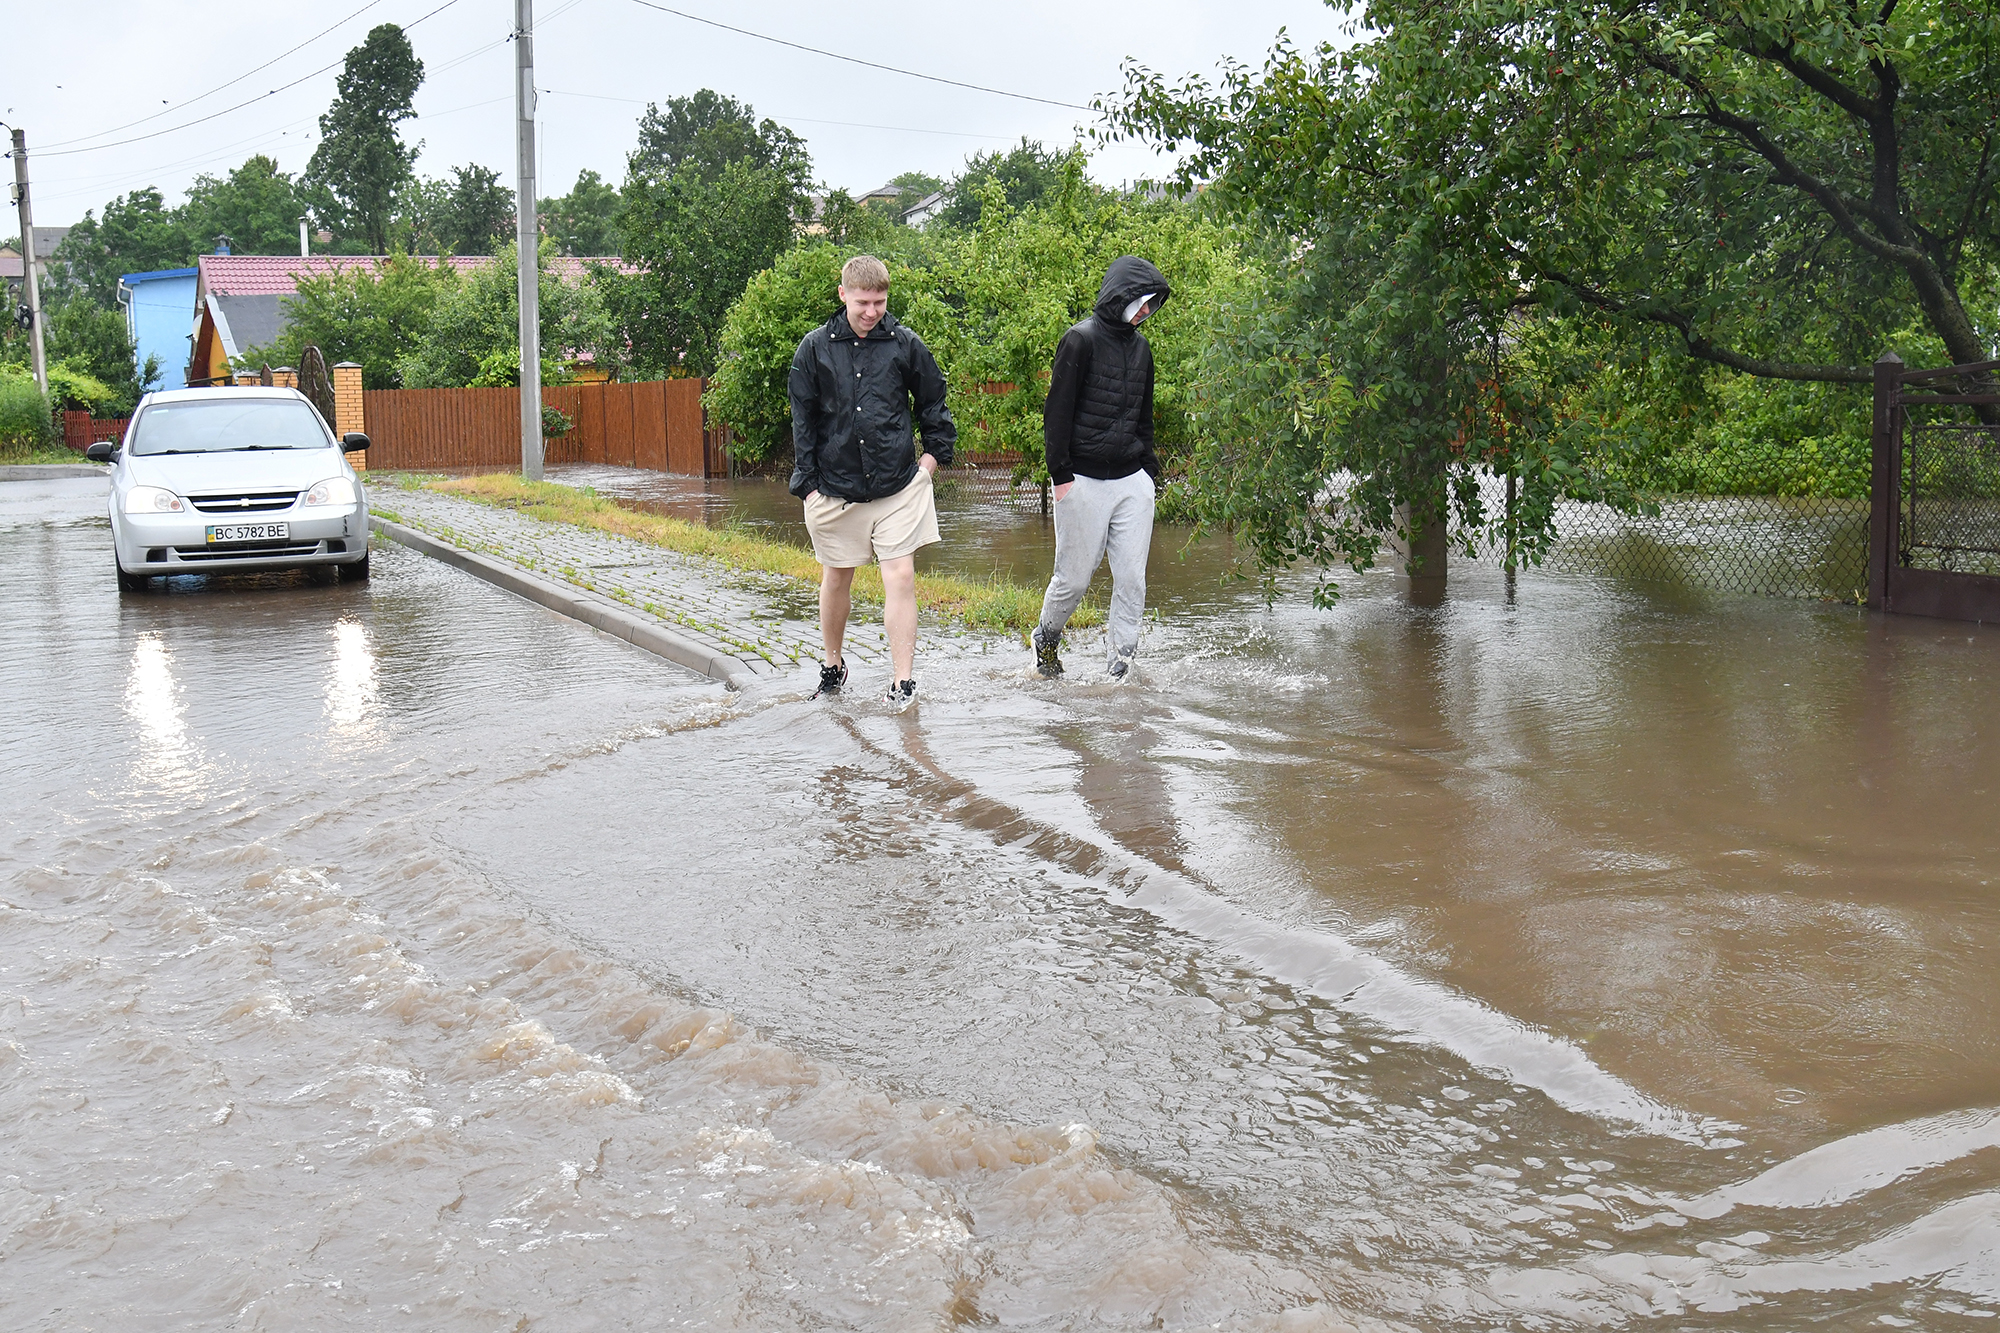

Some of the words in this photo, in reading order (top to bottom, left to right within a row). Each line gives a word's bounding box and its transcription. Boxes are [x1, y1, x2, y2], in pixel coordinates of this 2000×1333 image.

[215, 527, 233, 540] BC
[237, 526, 265, 539] 5782
[268, 525, 286, 537] BE
